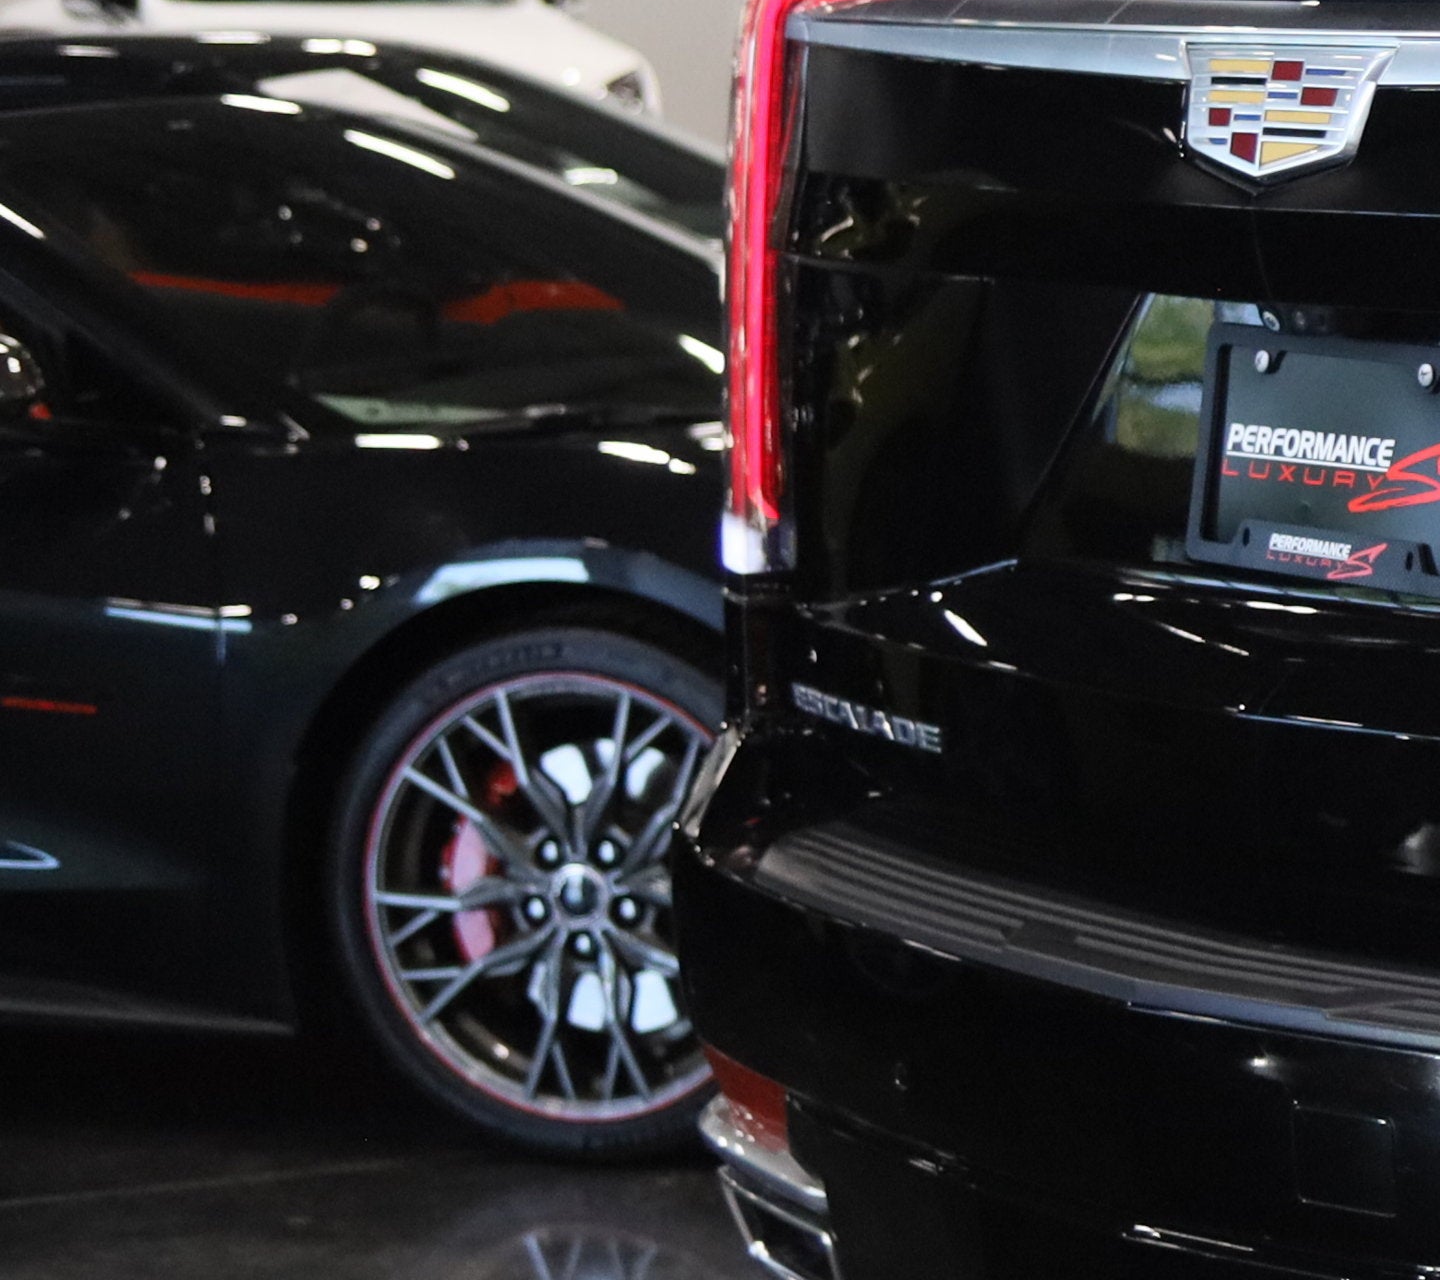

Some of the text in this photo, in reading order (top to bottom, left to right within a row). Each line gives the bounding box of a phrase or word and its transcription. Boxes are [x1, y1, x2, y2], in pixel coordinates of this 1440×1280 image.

[1225, 422, 1396, 468] PERFORMANCE
[1221, 458, 1386, 491] LUXURY
[1269, 532, 1352, 558] PERFORMANCE
[791, 681, 943, 754] ESCALADE
